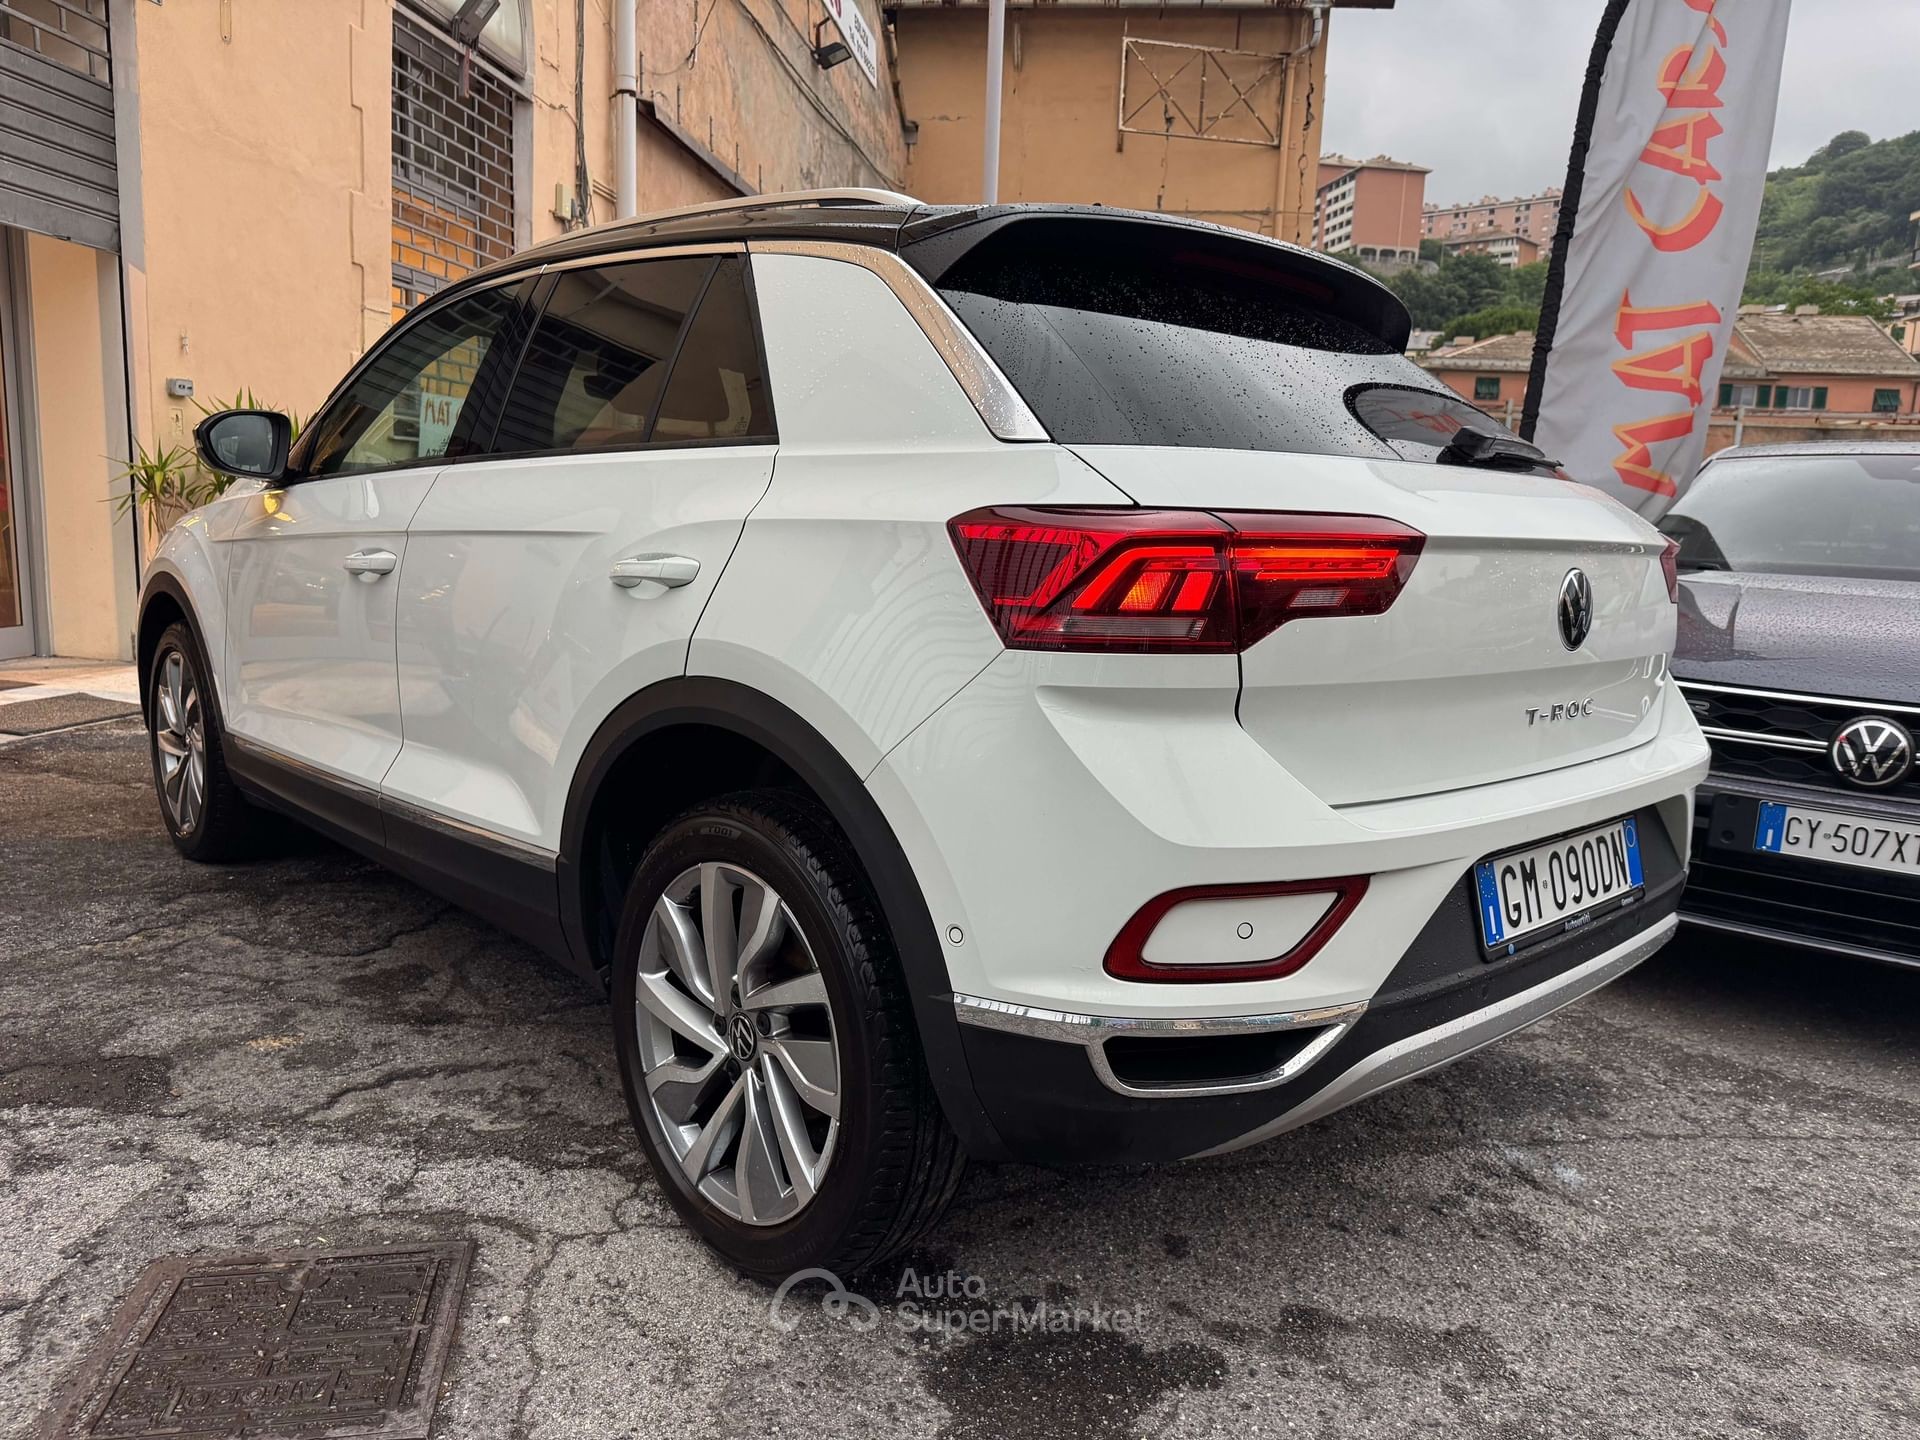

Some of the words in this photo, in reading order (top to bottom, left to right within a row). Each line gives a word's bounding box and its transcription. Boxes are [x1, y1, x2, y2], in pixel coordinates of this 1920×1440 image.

[1611, 288, 1722, 499] MAT
[1525, 697, 1594, 729] T-ROC
[1501, 856, 1543, 929] GM
[1548, 828, 1629, 911] 090DN
